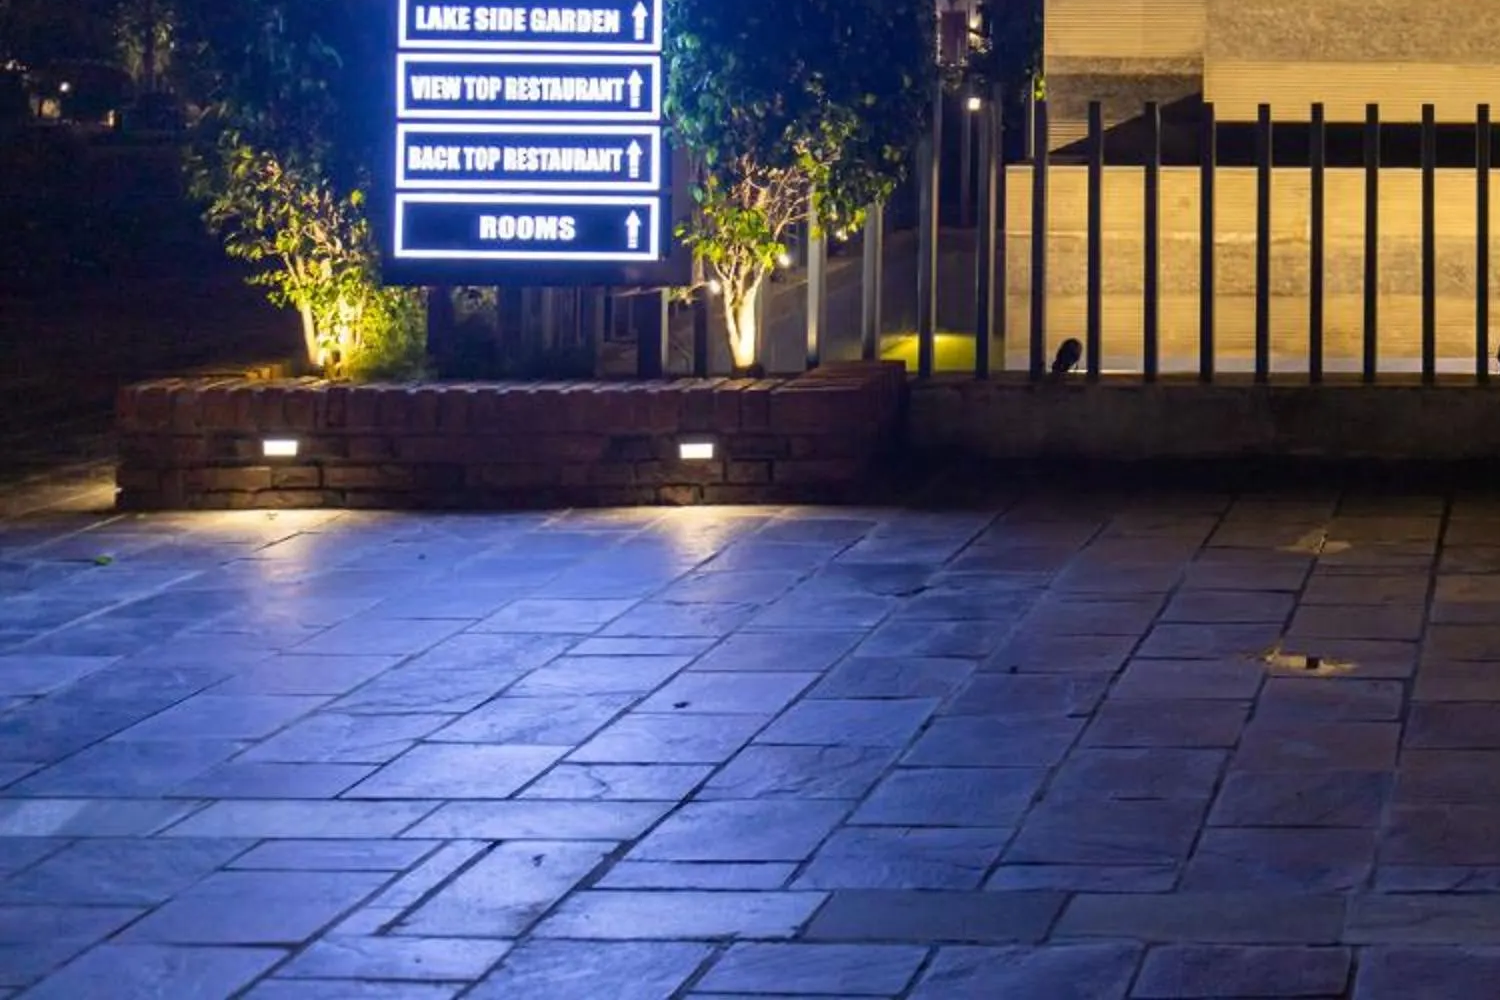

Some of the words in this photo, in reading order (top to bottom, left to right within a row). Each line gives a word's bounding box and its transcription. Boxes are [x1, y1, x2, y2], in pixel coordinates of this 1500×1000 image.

[416, 6, 470, 30] LAKE
[474, 7, 526, 31] SIDE
[530, 8, 620, 33] GARDEN
[410, 76, 462, 100] VIEW
[464, 76, 502, 100] TOP
[504, 76, 625, 101] RESTAURANT
[462, 146, 501, 171] TOP
[503, 147, 623, 172] RESTAURANT
[480, 216, 575, 240] ROOMS
